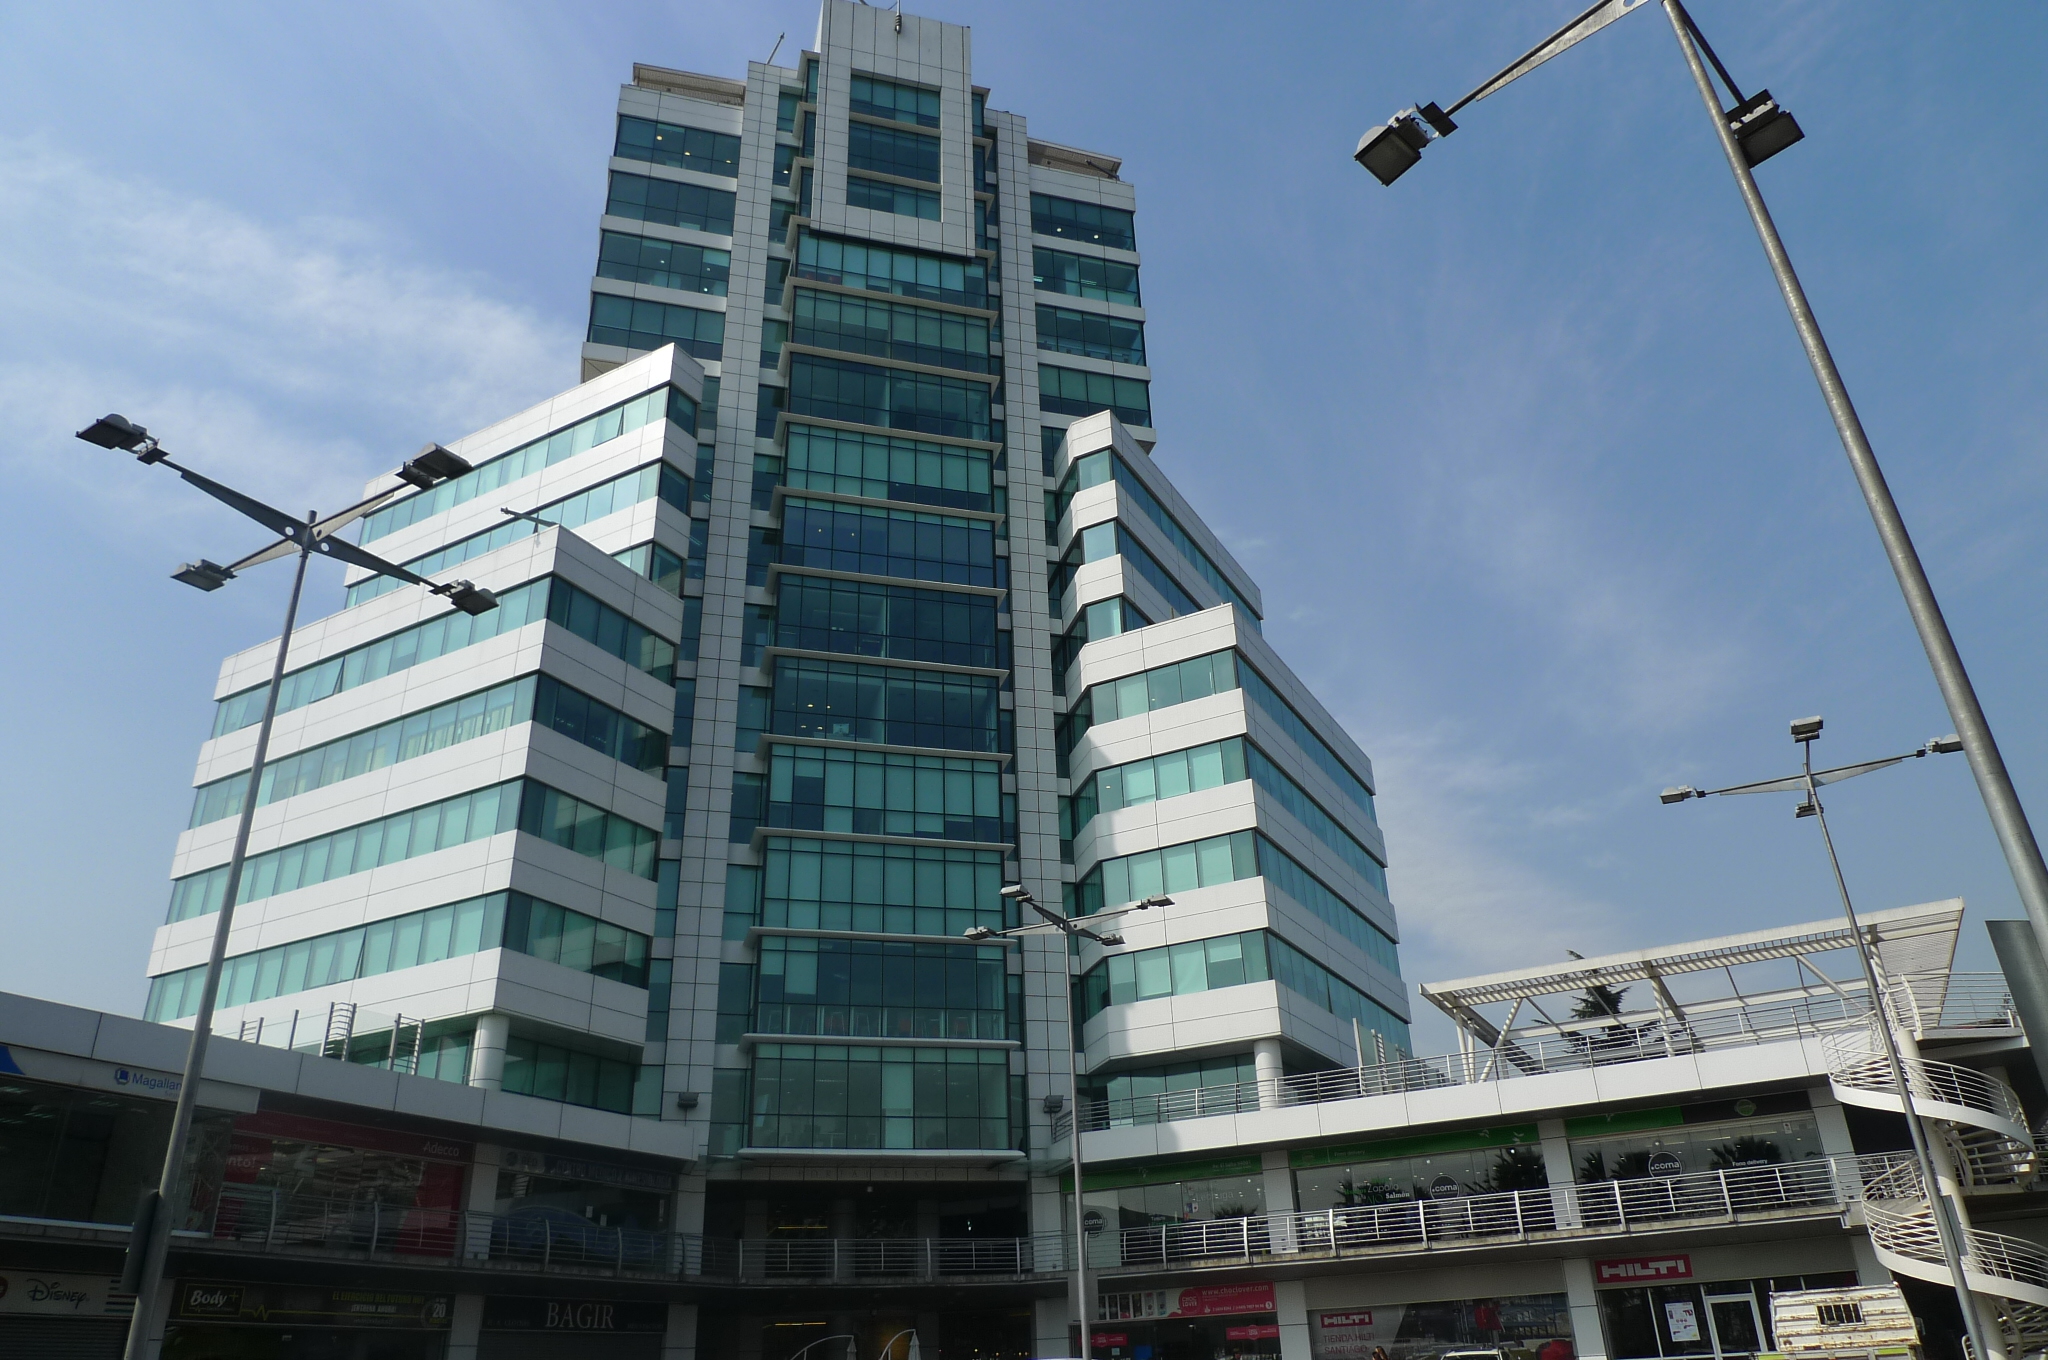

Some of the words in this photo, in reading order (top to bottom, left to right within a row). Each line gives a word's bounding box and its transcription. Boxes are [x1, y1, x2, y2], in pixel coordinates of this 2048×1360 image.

[131, 1072, 183, 1090] Magallan
[421, 1141, 460, 1157] Adecco
[1084, 1218, 1103, 1226] coma
[1601, 1259, 1686, 1278] HILTI
[1201, 1285, 1269, 1296] www.choclover.com
[432, 1303, 447, 1318] 20
[544, 1301, 615, 1330] BAGIR
[1323, 1313, 1370, 1326] HILTI
[1322, 1333, 1354, 1344] TIENDA
[1355, 1332, 1375, 1342] HILTI
[1324, 1344, 1368, 1355] SANTIAGO
